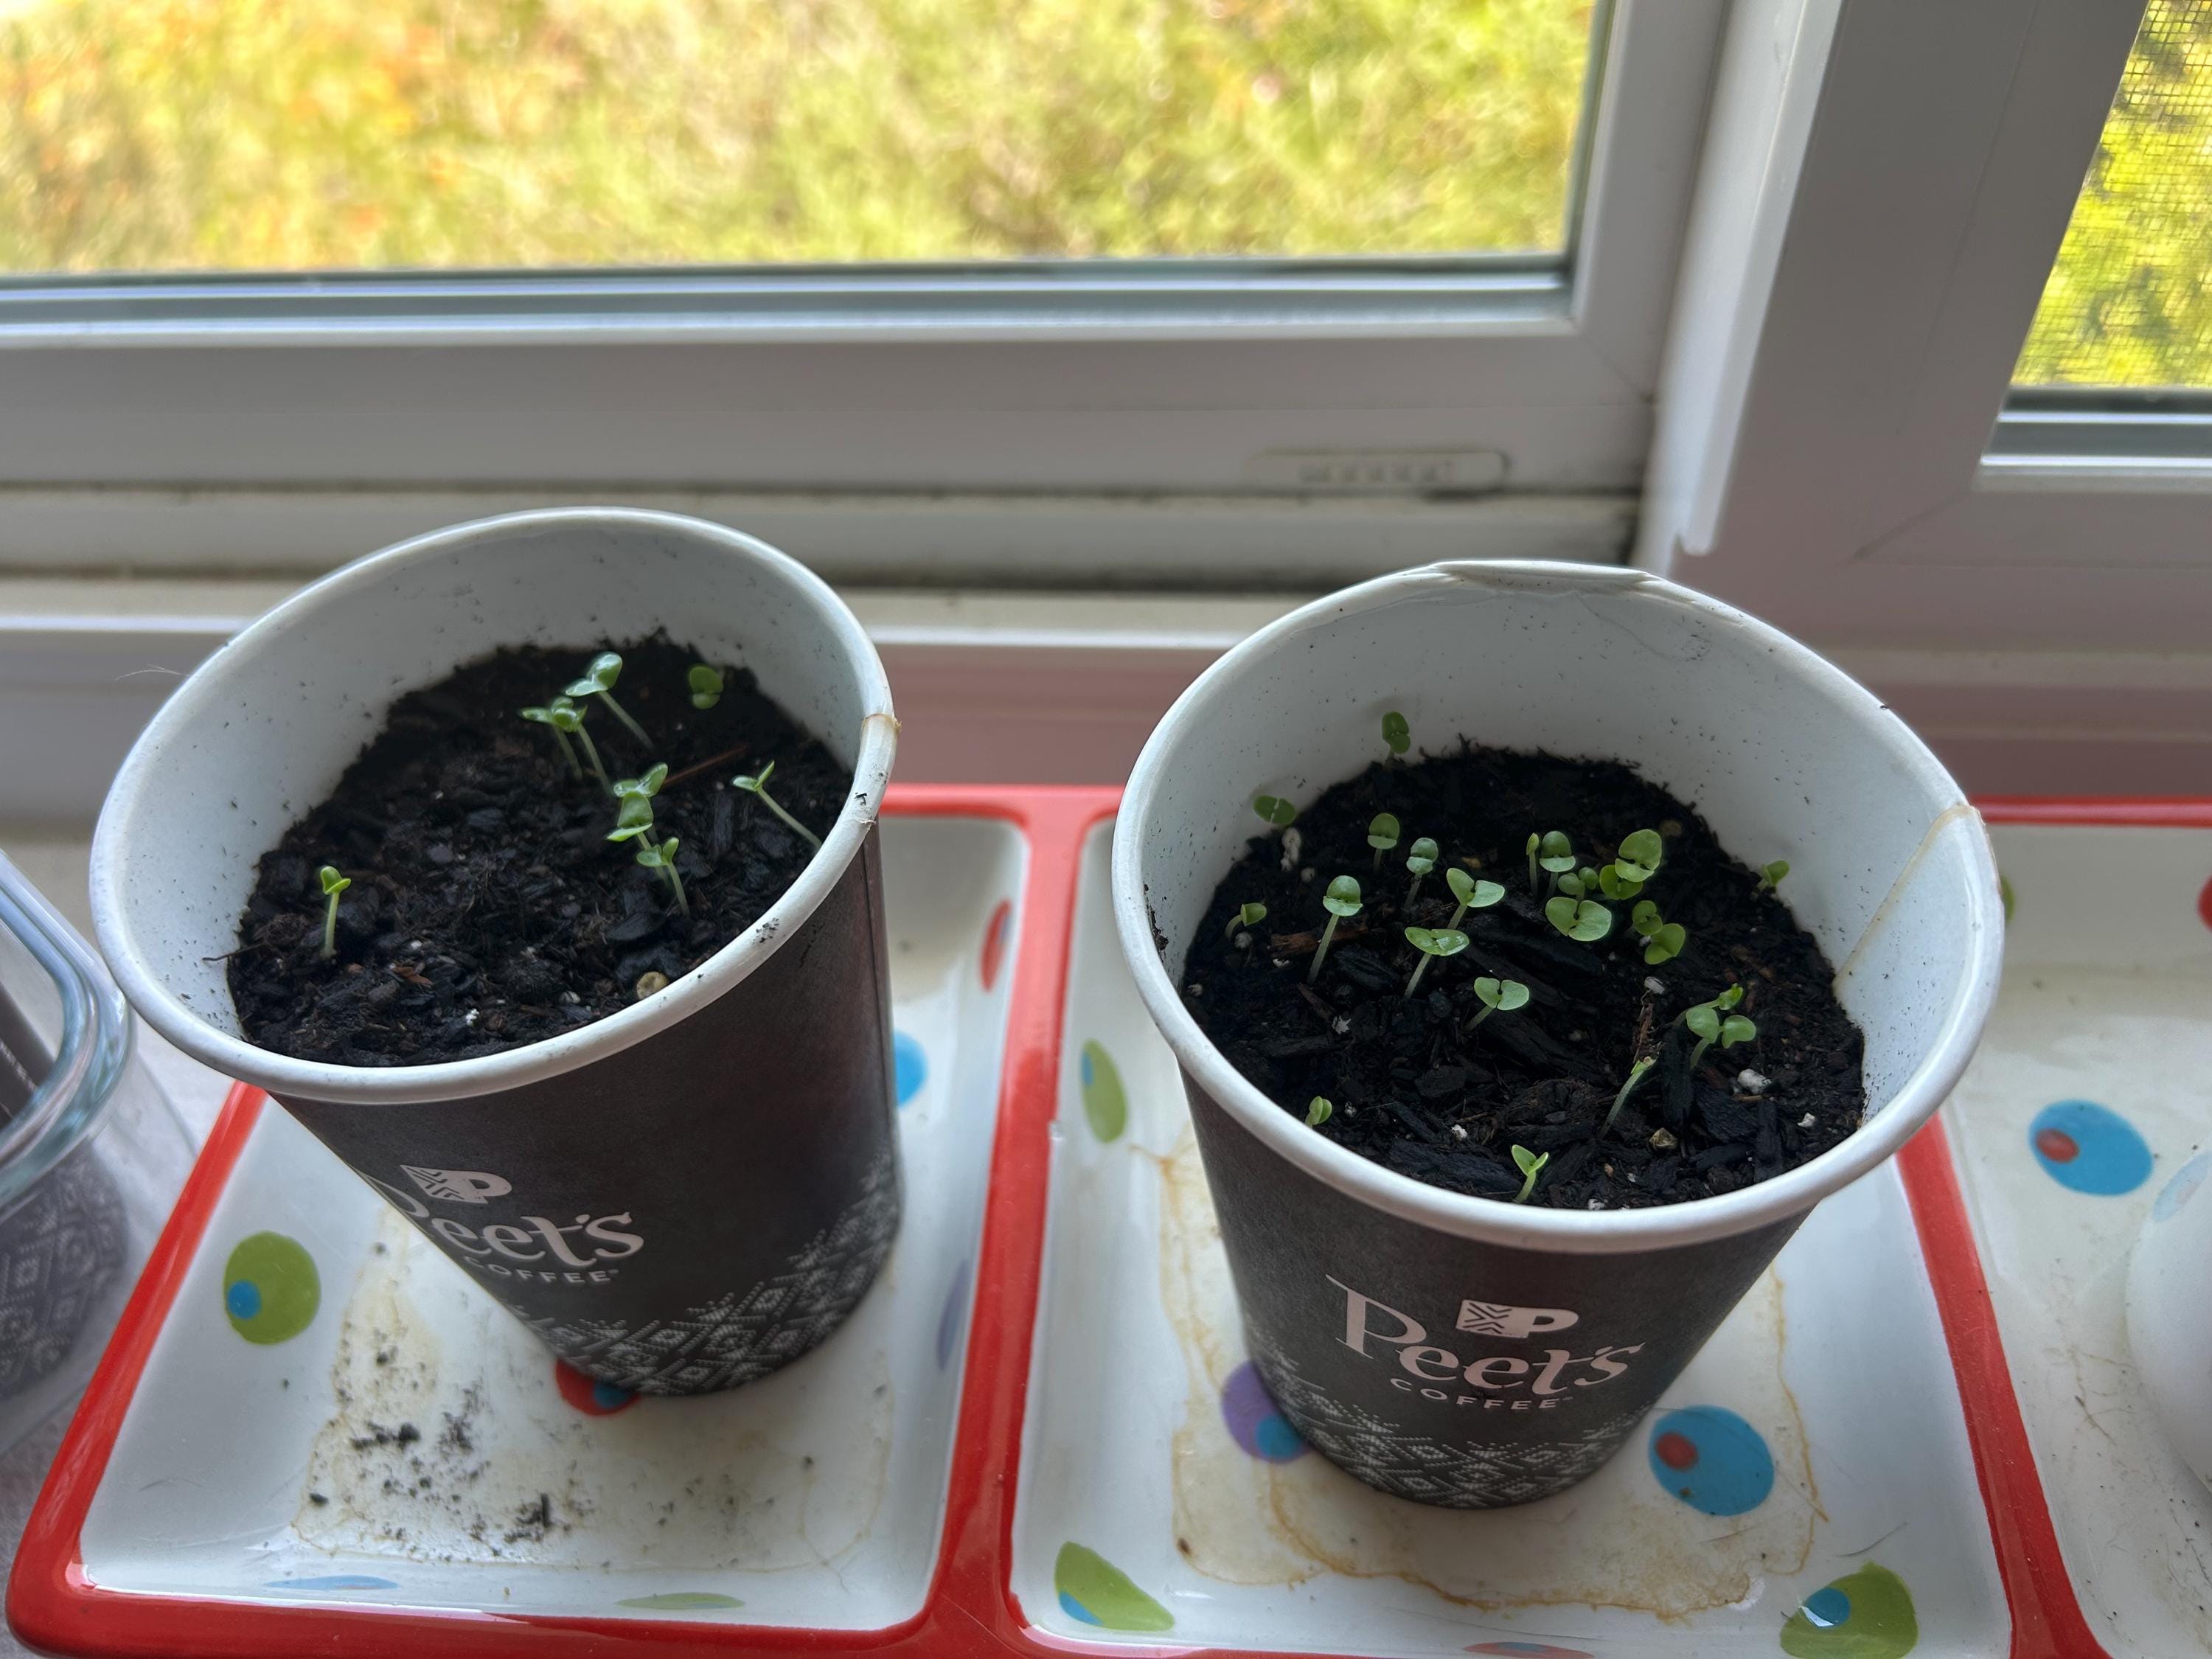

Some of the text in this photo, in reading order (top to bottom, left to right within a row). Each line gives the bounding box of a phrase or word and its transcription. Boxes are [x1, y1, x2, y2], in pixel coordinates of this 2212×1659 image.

[464, 1256, 611, 1284] COFFEE
[1326, 1274, 1646, 1395] Peet's
[1390, 1378, 1559, 1410] COFFEE
